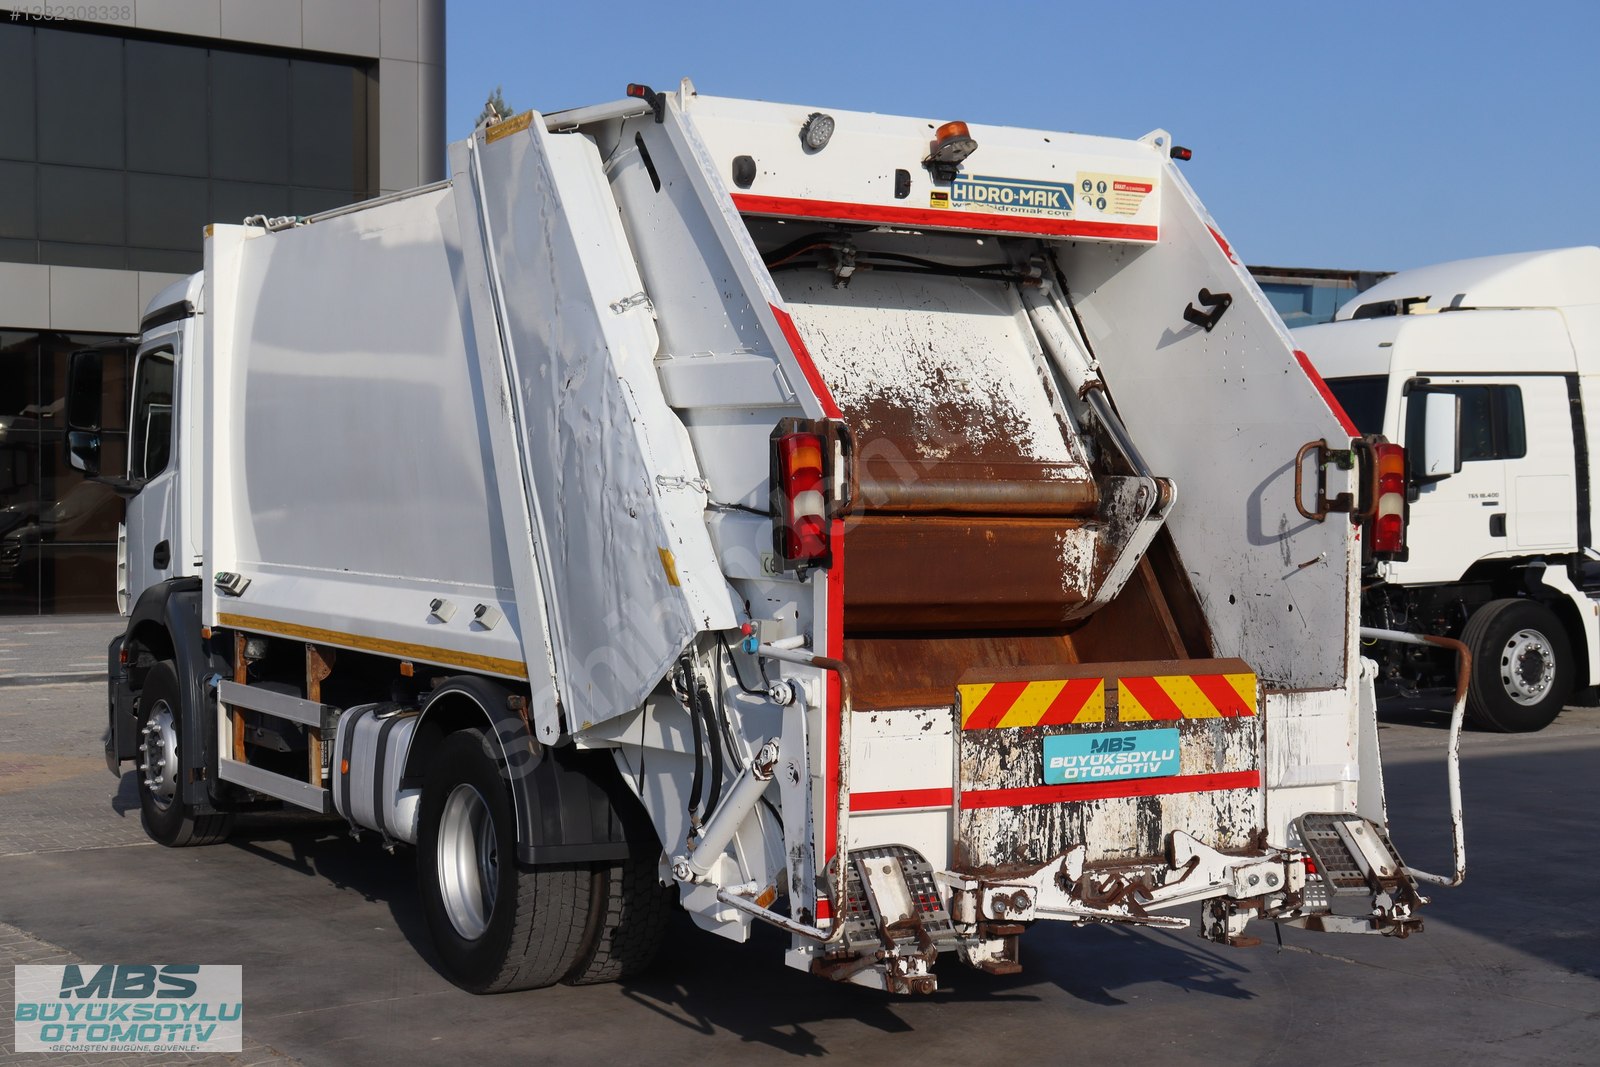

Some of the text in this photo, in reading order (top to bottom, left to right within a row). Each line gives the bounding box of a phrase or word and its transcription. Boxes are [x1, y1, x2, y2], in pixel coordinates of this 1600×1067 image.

[953, 183, 1061, 208] HIDRO-MAK
[1090, 736, 1137, 754] MBS
[1050, 749, 1175, 769] BÜYÜKSOYLU
